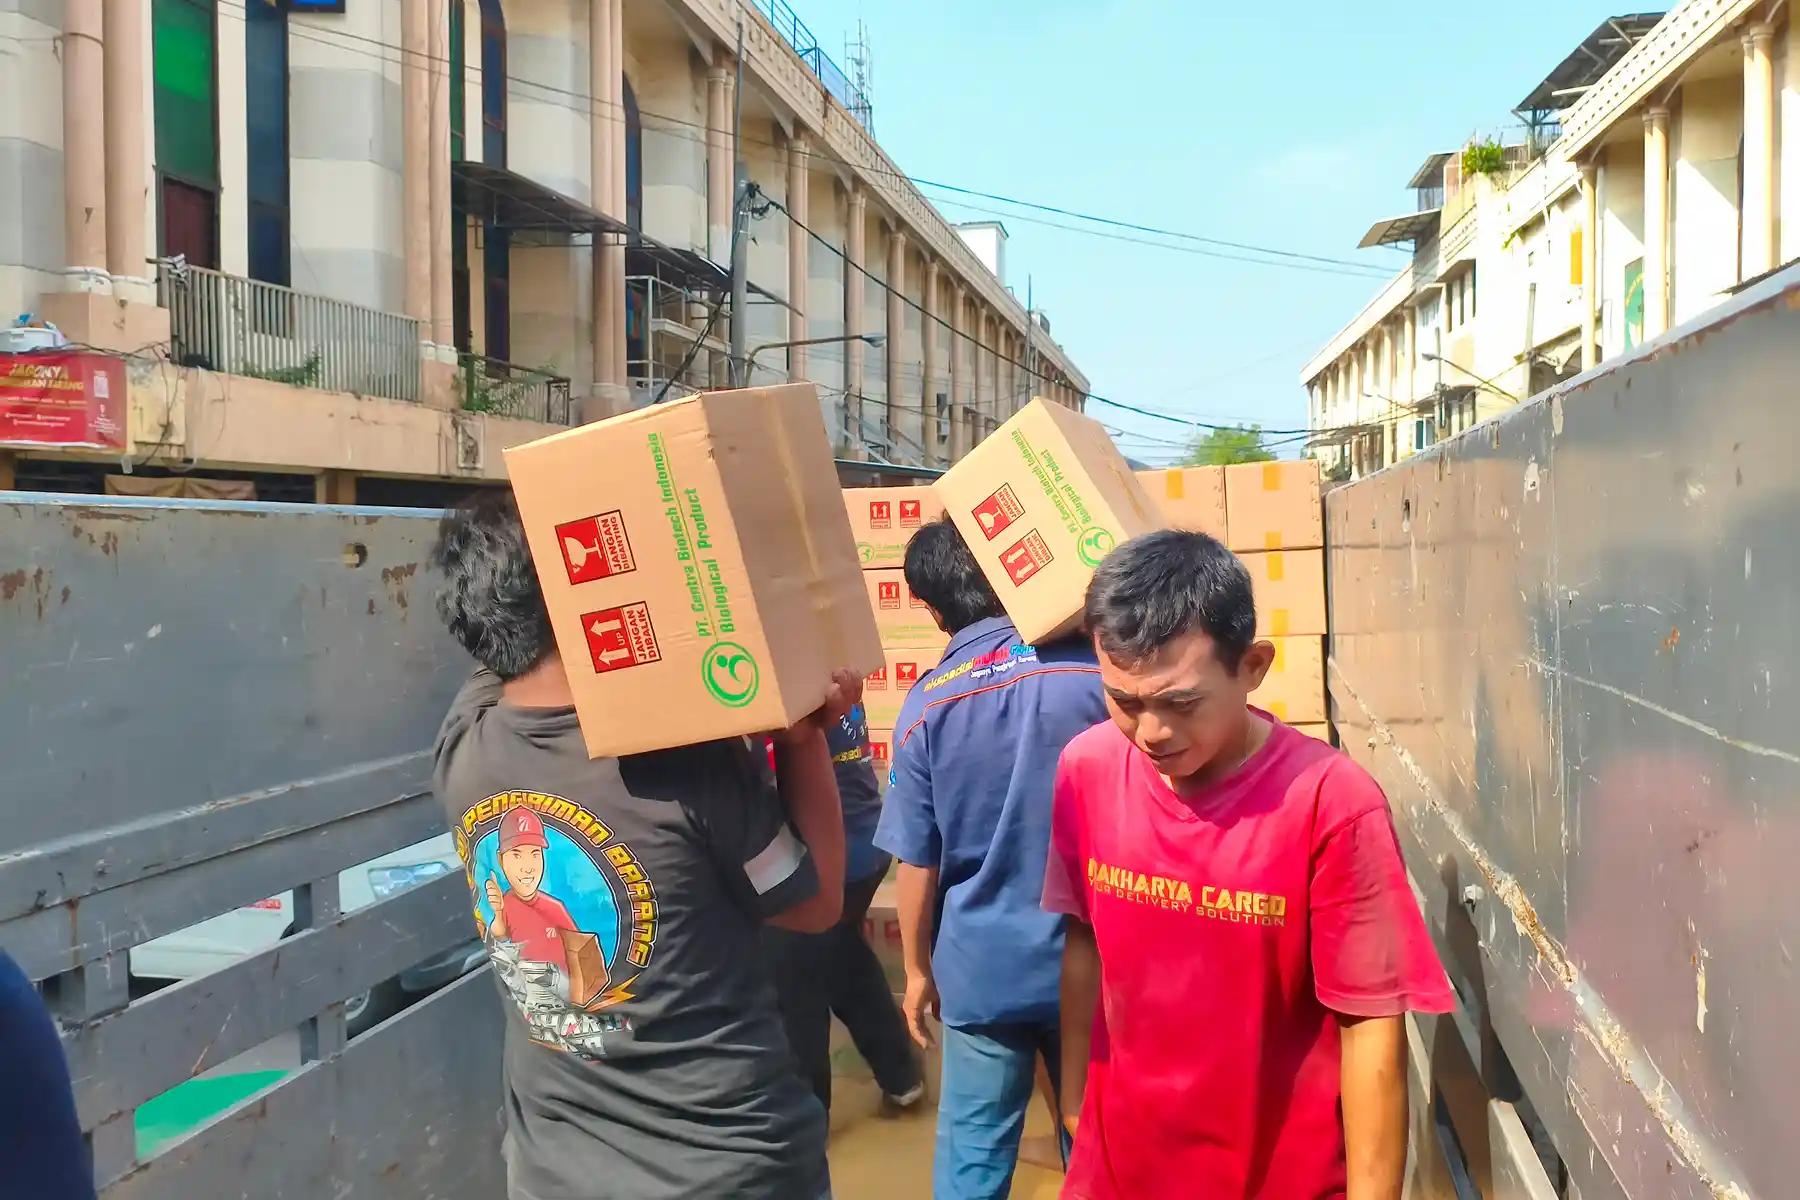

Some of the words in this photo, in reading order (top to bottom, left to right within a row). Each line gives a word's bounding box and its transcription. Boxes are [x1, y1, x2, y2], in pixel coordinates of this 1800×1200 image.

[647, 432, 674, 503] Indonesia
[601, 518, 622, 570] JANGAN
[610, 516, 630, 570] DIBANTING
[665, 506, 691, 562] Biotech
[684, 488, 713, 550] Product
[684, 565, 705, 613] Centra
[701, 558, 735, 634] Biological
[616, 632, 626, 646] UP
[626, 609, 647, 660] JANGAN
[637, 608, 657, 659] DIBALIK
[462, 791, 613, 846] PENGIRIMAN
[602, 844, 657, 967] BARANG
[1116, 888, 1189, 913] DELIVERY
[1195, 906, 1285, 927] SOLUTION
[1201, 885, 1286, 916] CARGO
